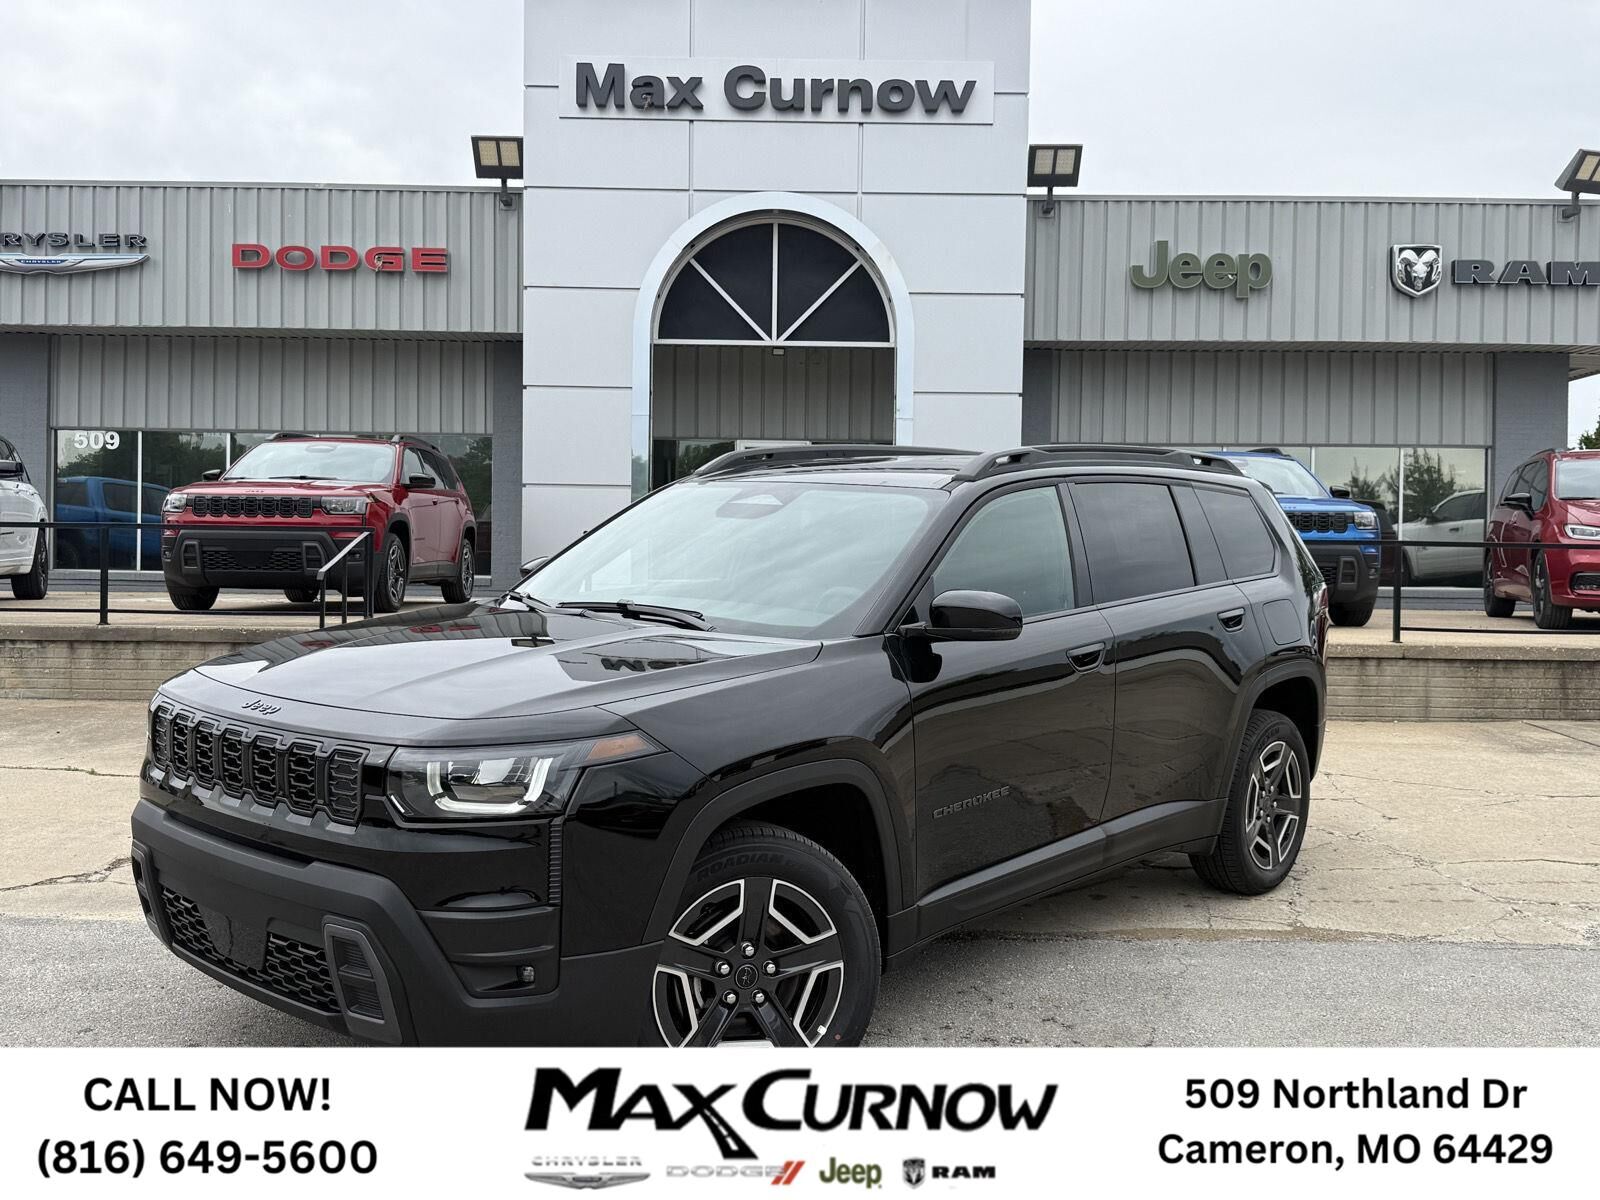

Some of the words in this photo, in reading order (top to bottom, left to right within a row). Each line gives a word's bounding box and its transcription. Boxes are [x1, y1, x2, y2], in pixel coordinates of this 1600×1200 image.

[576, 62, 704, 111] Max
[723, 64, 977, 114] Curnow
[231, 243, 449, 273] DODGE
[1130, 240, 1273, 299] Jeep
[1451, 259, 1600, 286] RAM
[73, 431, 120, 450] 509
[241, 699, 282, 716] Jeep
[932, 785, 1010, 819] CHEROKEE
